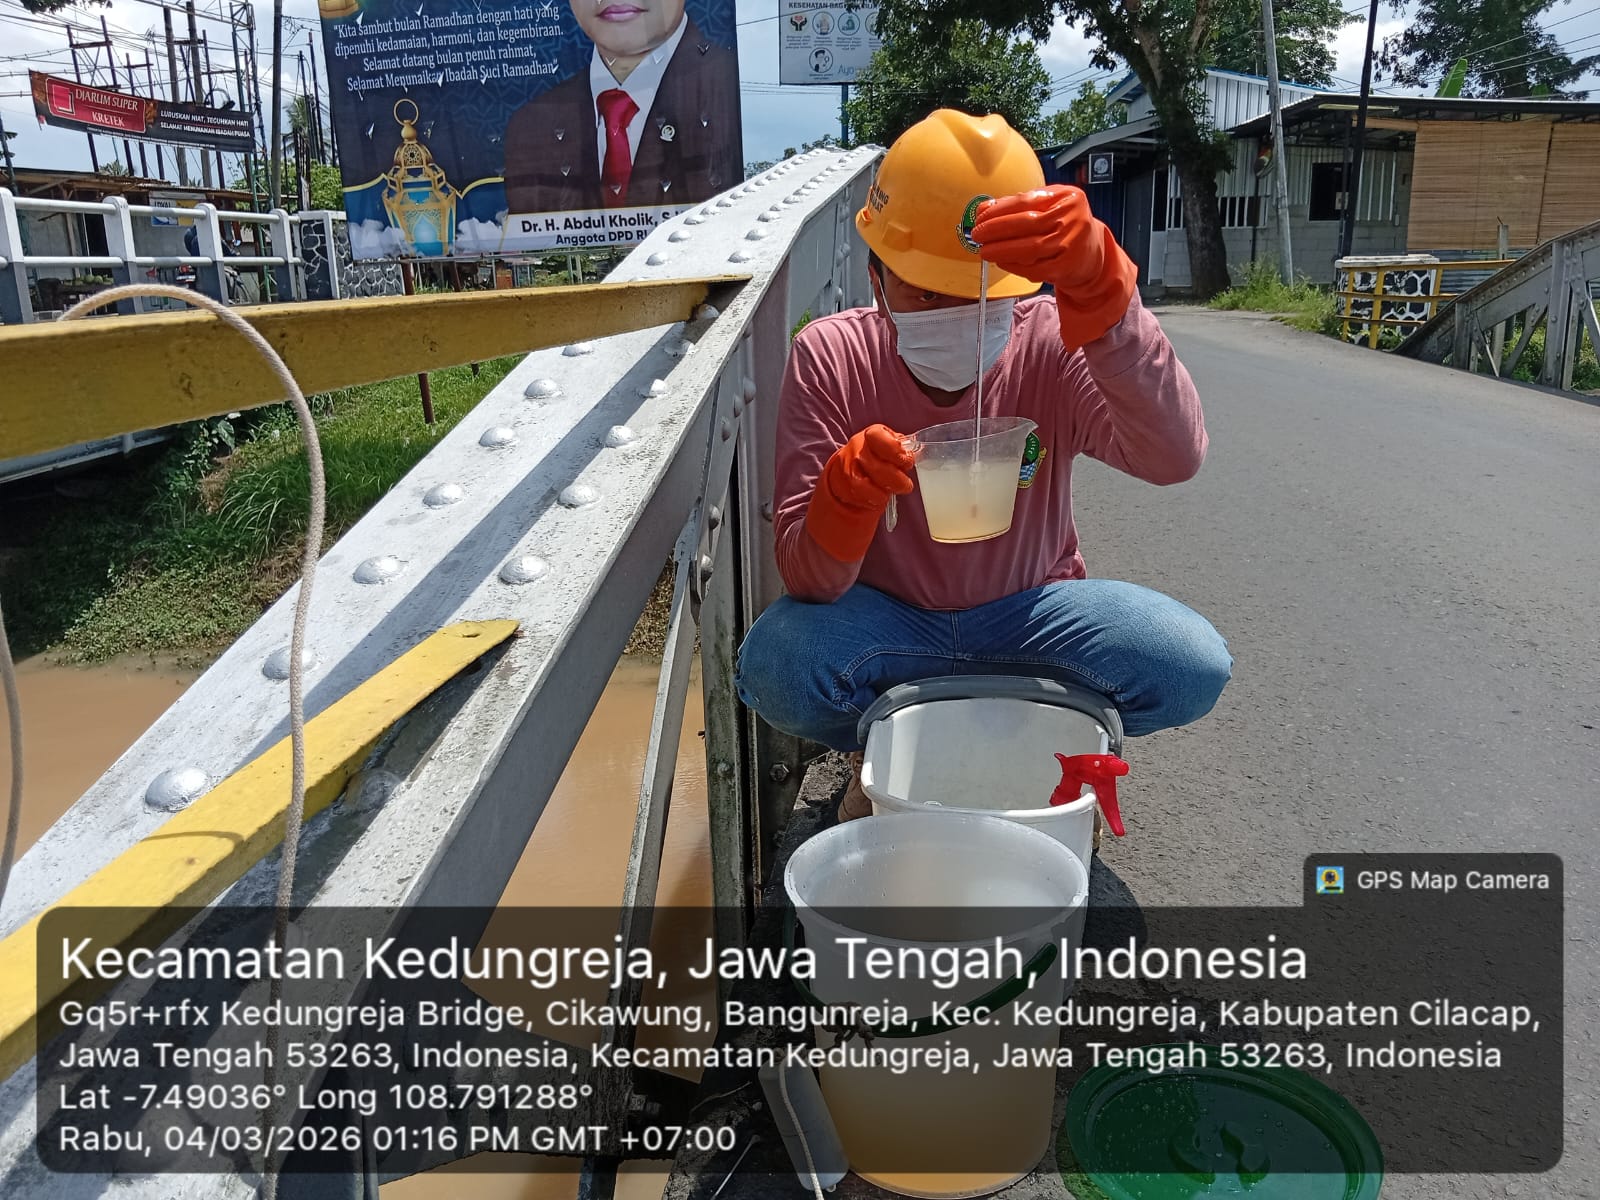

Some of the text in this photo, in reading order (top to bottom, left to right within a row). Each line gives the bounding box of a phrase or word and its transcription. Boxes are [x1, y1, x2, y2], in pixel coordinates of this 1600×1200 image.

[358, 20, 393, 36] sambut
[394, 17, 421, 32] bulan
[423, 11, 474, 29] Ramadhan
[476, 8, 511, 26] dengan
[513, 5, 533, 20] hati
[535, 6, 560, 22] yang
[335, 23, 564, 59] dipenuhi kedamaian, harmoni, dan kegembiraan.
[363, 44, 537, 72] Selamat datang bulan penuh rahmat,
[347, 75, 385, 91] Selamat
[385, 69, 443, 87] Menunaikan
[445, 65, 479, 82] Ibadah
[480, 64, 500, 80] Suci
[75, 88, 139, 112] DJARUM SUPER
[92, 111, 125, 127] KRETEK
[160, 110, 191, 121] LURUSKAN
[191, 114, 206, 124] NIAT,
[207, 116, 236, 126] TEGUHKAN
[160, 121, 183, 131] SELAMAT
[234, 130, 251, 138] PUASA
[521, 220, 542, 233] Dr.
[544, 218, 560, 232] H.
[563, 214, 606, 230] Abdul
[608, 212, 658, 229] Kholik,
[555, 229, 648, 247] Anggota DPD RI
